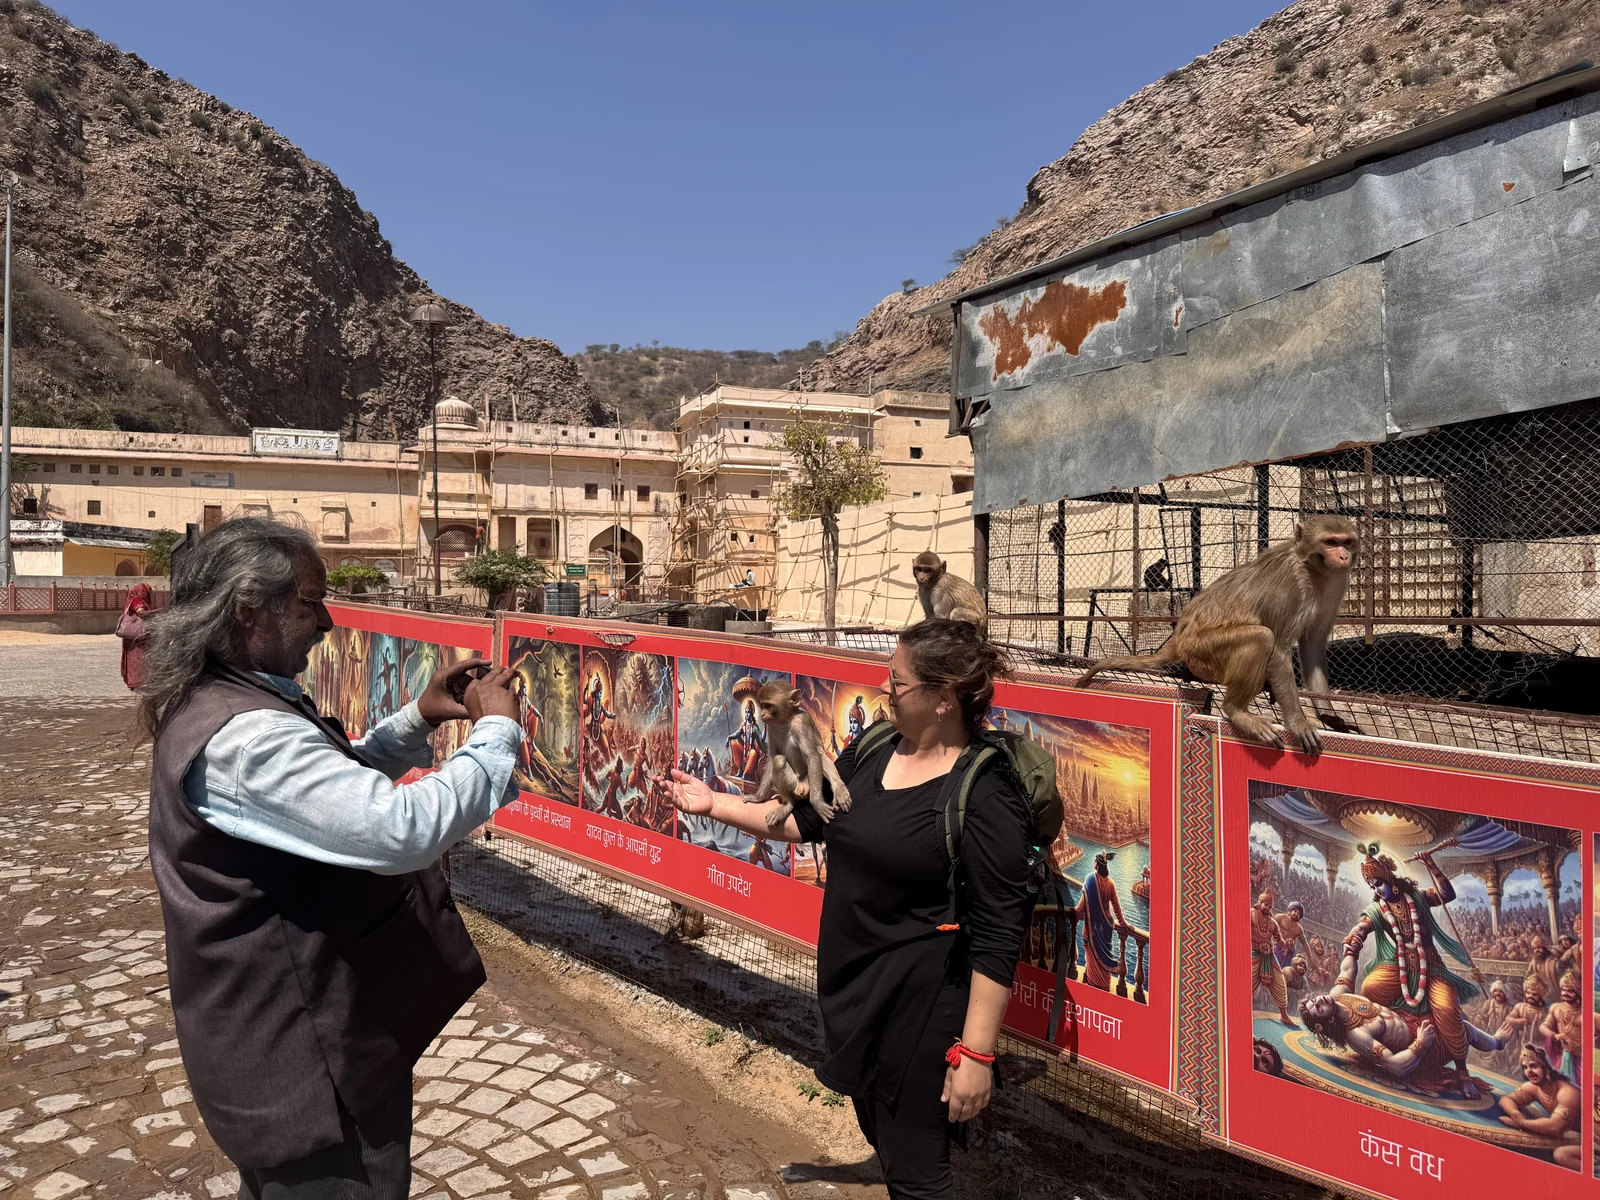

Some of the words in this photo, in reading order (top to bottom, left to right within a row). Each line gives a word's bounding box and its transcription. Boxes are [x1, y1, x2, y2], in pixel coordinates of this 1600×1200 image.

[523, 800, 530, 816] के
[529, 804, 543, 822] पृथ्वी
[543, 806, 550, 823] से
[550, 812, 572, 830] प्रस्थान
[586, 824, 602, 841] यादव
[602, 829, 616, 848] कुल
[617, 830, 625, 848] के
[625, 838, 648, 857] आपसी
[649, 844, 662, 865] युद्ध
[707, 863, 725, 888] गीता
[726, 873, 752, 898] उपदेश
[1009, 980, 1038, 1009] गरी
[1063, 1000, 1123, 1040] स्थापना
[1358, 1128, 1403, 1168] कंस
[1407, 1147, 1445, 1182] वध
